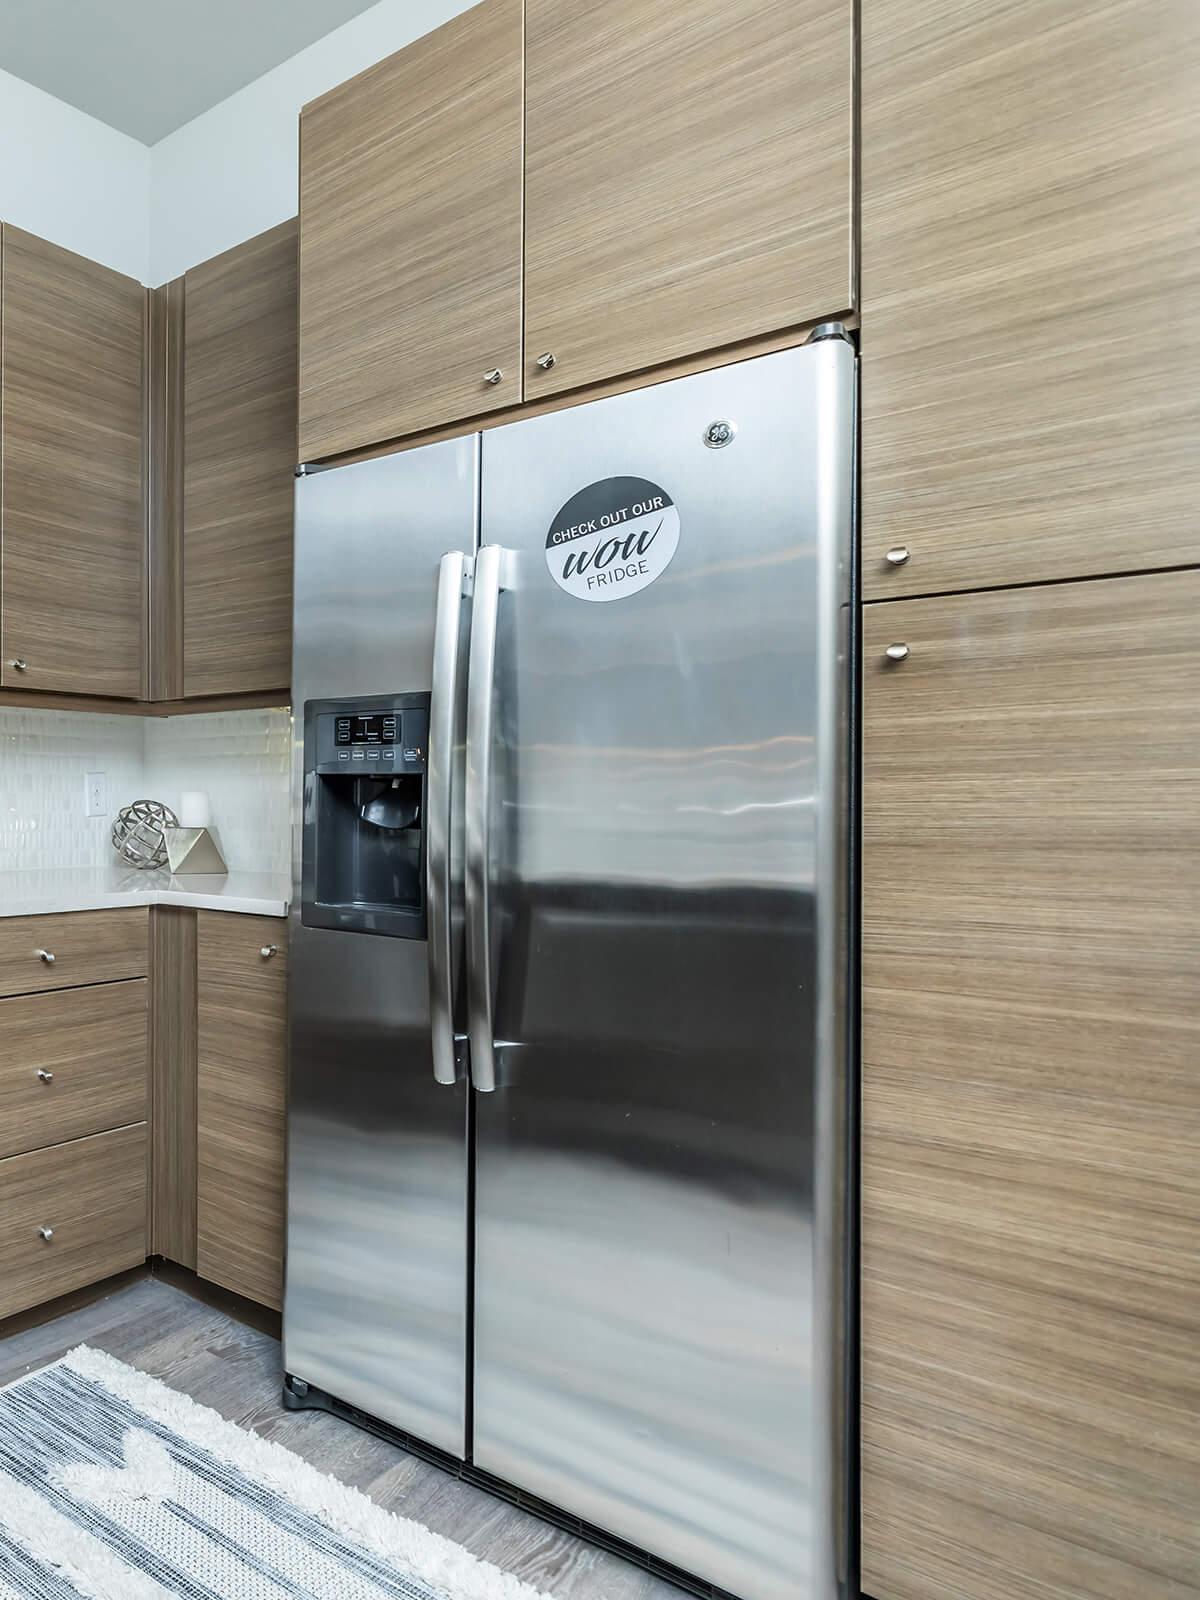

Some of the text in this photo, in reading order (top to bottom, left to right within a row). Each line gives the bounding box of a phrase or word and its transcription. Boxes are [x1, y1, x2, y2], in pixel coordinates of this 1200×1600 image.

[552, 496, 664, 544] CHECK OUT OUR
[587, 559, 649, 590] FRIDGE
